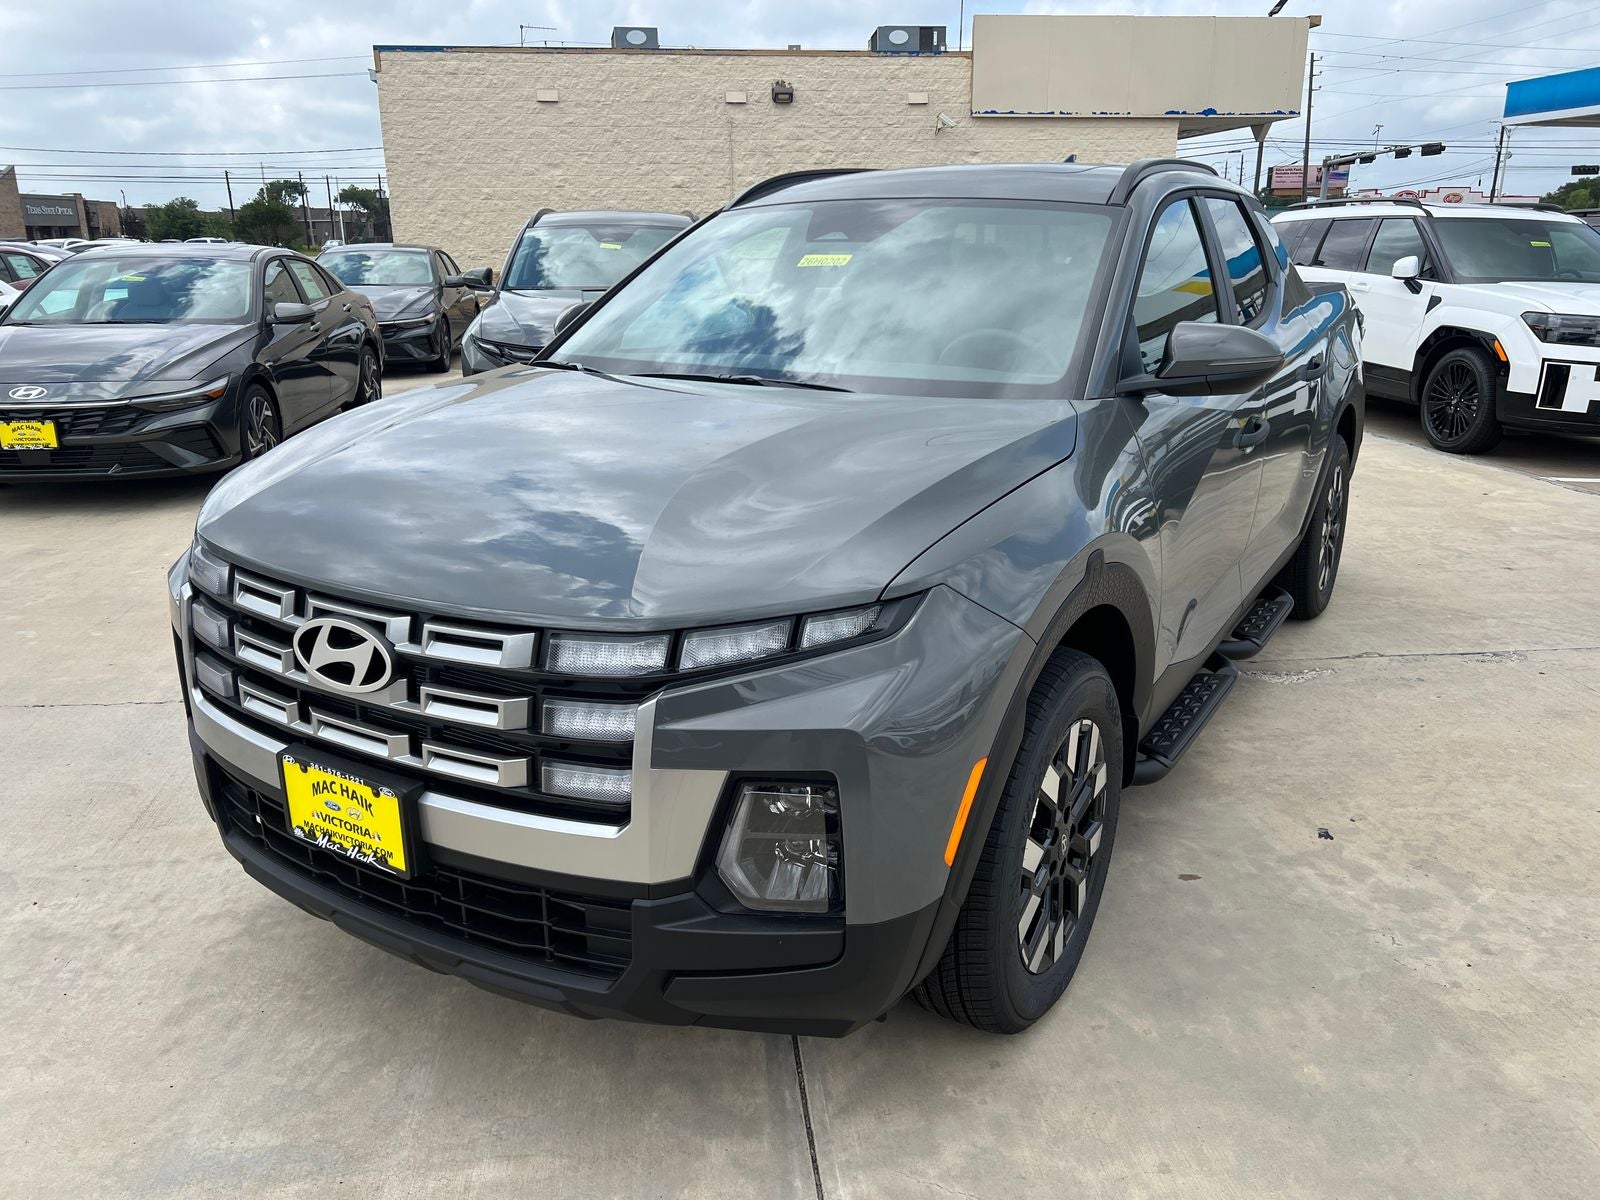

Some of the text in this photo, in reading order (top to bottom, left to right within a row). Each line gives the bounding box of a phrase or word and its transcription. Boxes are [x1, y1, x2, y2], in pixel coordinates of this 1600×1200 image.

[311, 780, 374, 817] MAC HAIK
[303, 819, 394, 860] MACHAIKVICTORIA.COM
[319, 811, 373, 840] VICTORIA
[315, 835, 379, 864] Mac Haik
